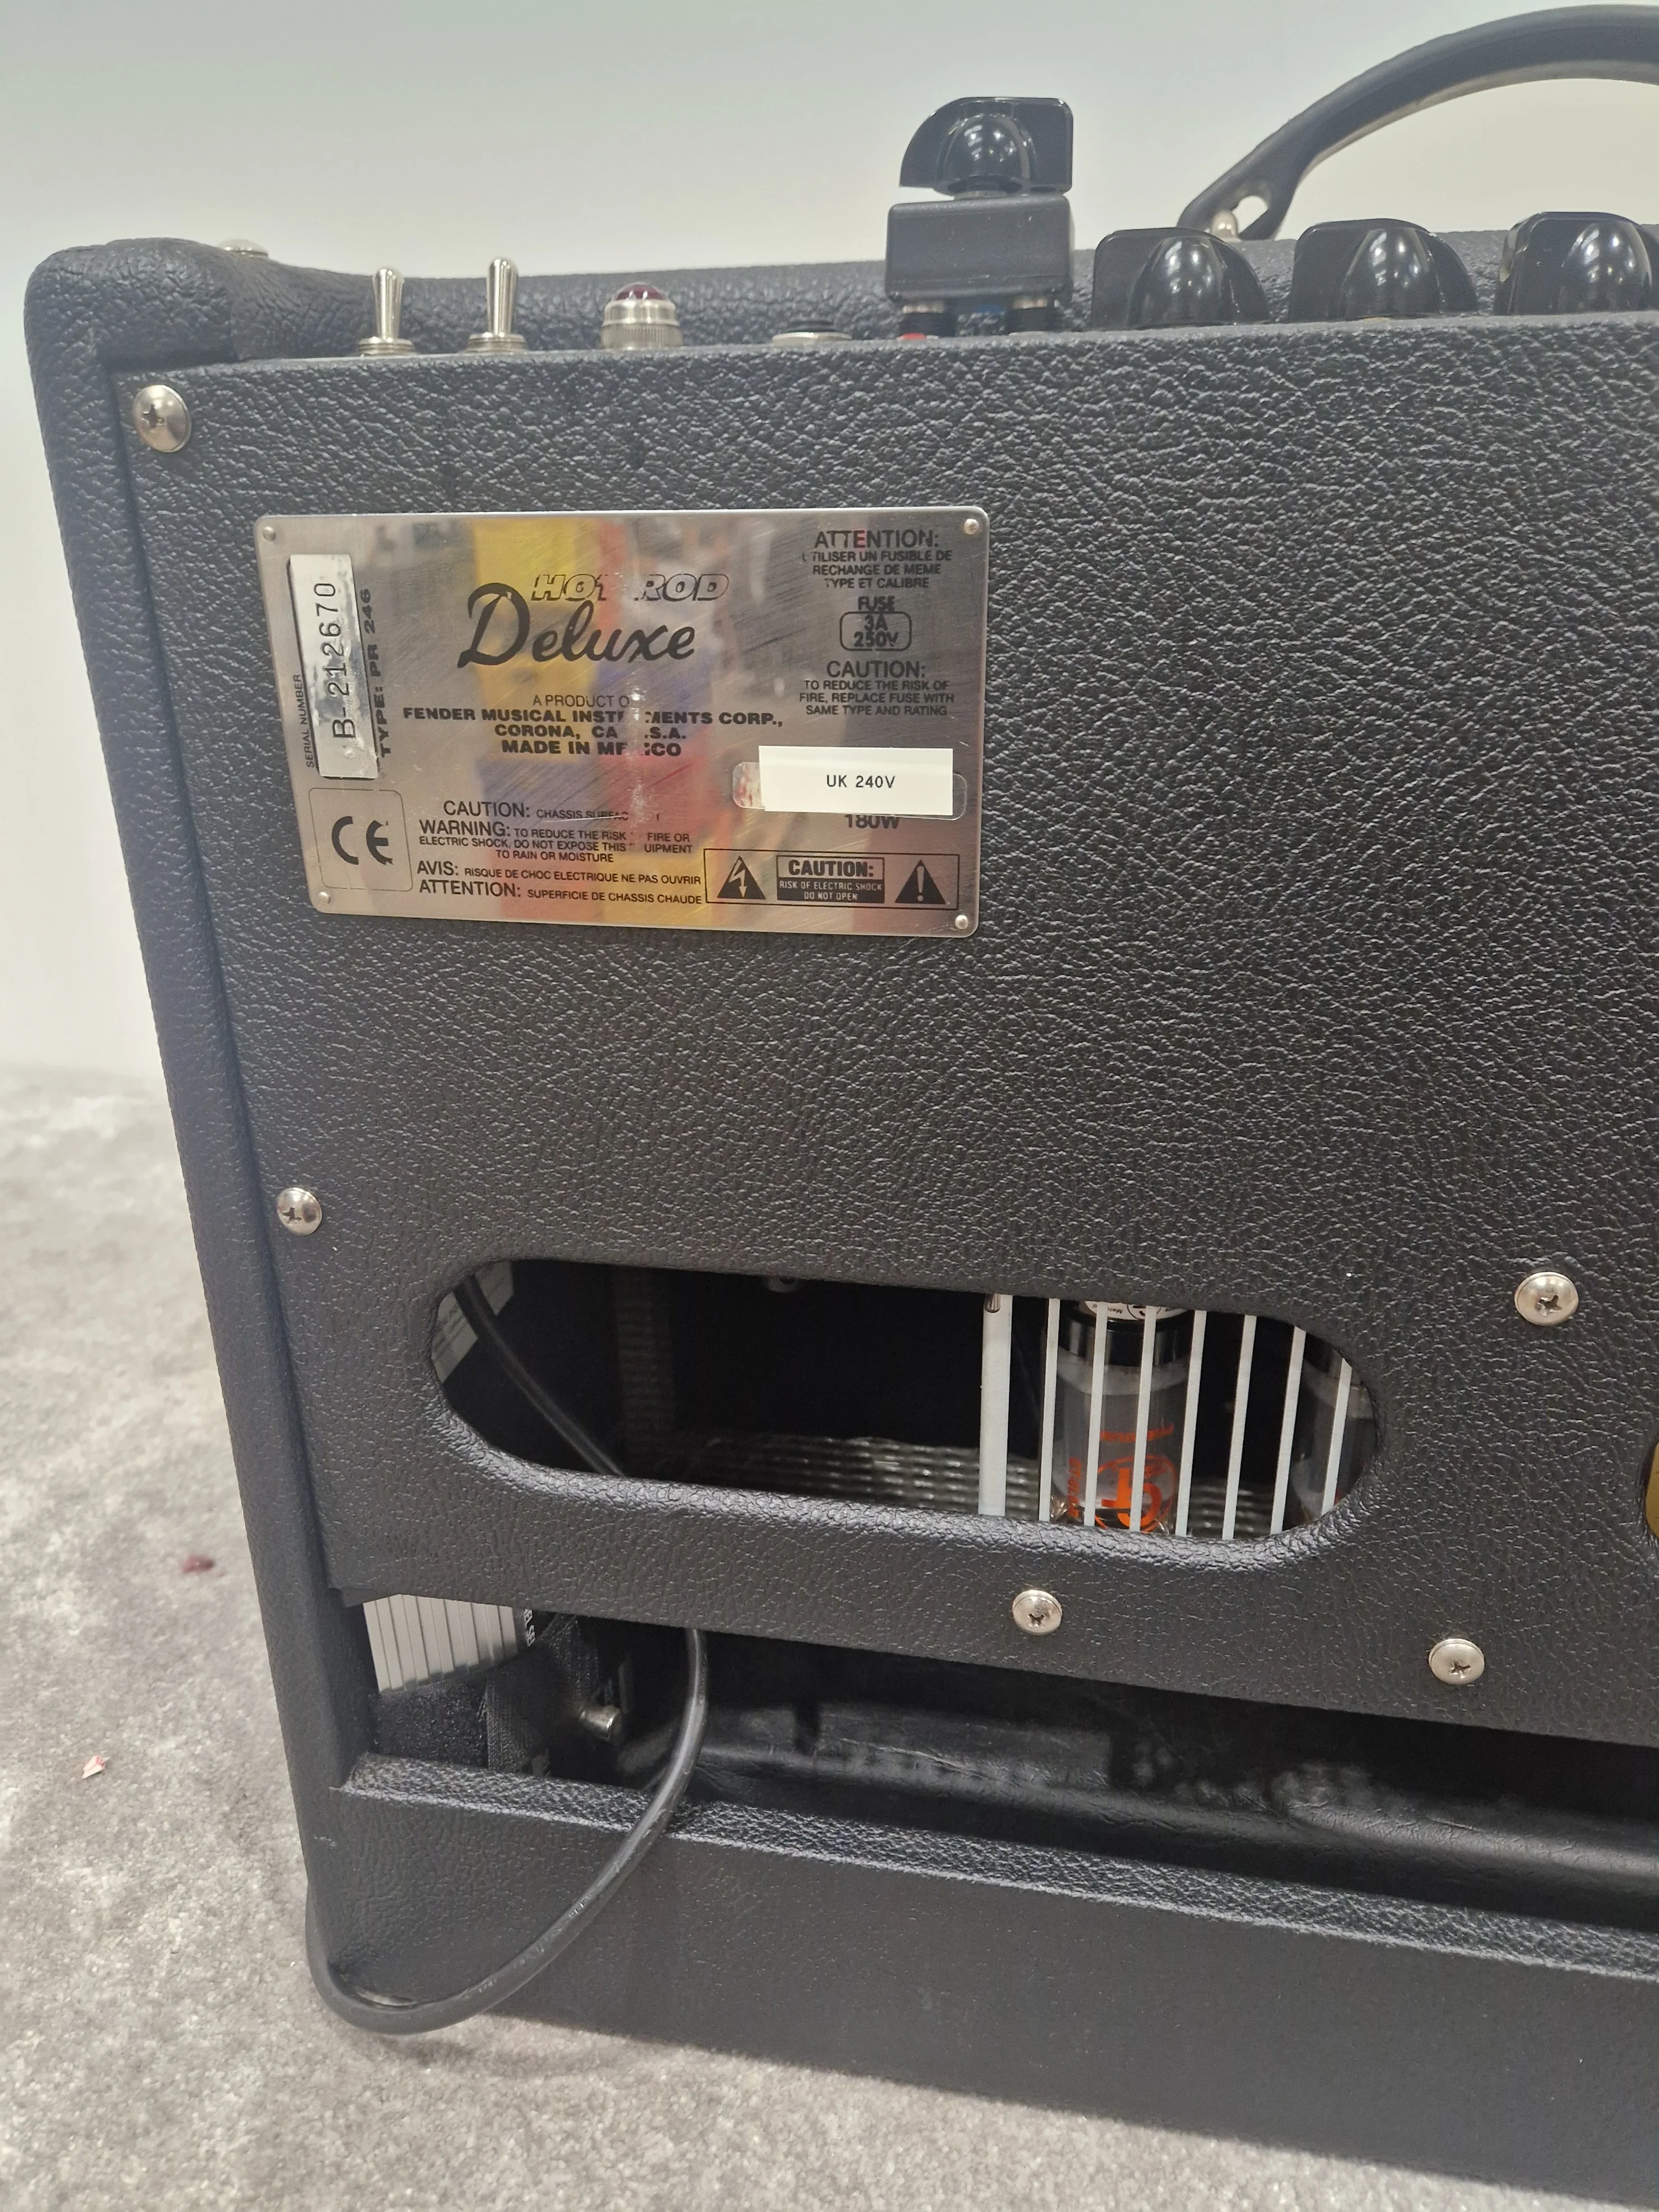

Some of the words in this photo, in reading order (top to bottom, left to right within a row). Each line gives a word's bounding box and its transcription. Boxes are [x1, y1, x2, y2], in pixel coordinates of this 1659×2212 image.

[813, 529, 939, 549] ATTENTION:
[859, 551, 877, 562] UN
[880, 550, 932, 561] FUSIBLE
[936, 550, 952, 561] DE
[813, 565, 880, 576] RECHANGE
[884, 565, 900, 575] DE
[904, 564, 941, 575] MEME
[634, 573, 729, 602] ROD
[824, 578, 855, 589] TYPE
[858, 577, 873, 588] ET
[877, 577, 930, 588] CALIBRE
[361, 588, 375, 634] 246
[858, 596, 895, 613] FUSE
[457, 582, 695, 669] Deluxe
[864, 614, 888, 631] 3A
[853, 630, 899, 648] 250V
[367, 644, 382, 677] PR
[827, 660, 926, 679] CAUTION:
[804, 680, 820, 691] TO
[823, 680, 872, 691] REDUCE
[875, 680, 899, 691] THE
[902, 680, 930, 691] RISK
[933, 680, 950, 691] OF
[294, 674, 307, 724] NUMBER
[533, 695, 542, 706] A
[545, 695, 613, 707] PRODUCT
[619, 695, 633, 708] O
[799, 692, 828, 704] FIRE,
[832, 692, 885, 703] REPLACE
[889, 692, 920, 703] FUSE
[924, 693, 954, 704] WITH
[403, 707, 476, 720] FENDER
[482, 709, 566, 723] MUSICAL
[573, 709, 713, 724] INSTMENTS
[806, 705, 838, 716] SAME
[842, 705, 872, 716] TYPE
[875, 705, 900, 716] AND
[904, 705, 948, 716] RATING
[373, 686, 391, 758] TYPE:
[494, 724, 580, 740] CORONA,
[634, 726, 686, 739] .S.A.
[302, 726, 315, 768] SERIAL
[502, 740, 562, 754] MADE
[568, 741, 591, 755] IN
[598, 742, 681, 757] MEICO
[827, 775, 847, 788] UK
[855, 775, 896, 789] 240V
[444, 800, 530, 817] CAUTION:
[536, 810, 582, 819] CHASSIS
[586, 811, 630, 821] SURFAC
[419, 819, 510, 837] WARNING:
[514, 828, 528, 837] TO
[531, 829, 575, 839] REDUCE
[578, 830, 599, 839] THE
[602, 831, 627, 841] RISK
[647, 832, 671, 842] FIRE
[674, 833, 690, 842] OR
[845, 814, 900, 830] 180W
[419, 836, 469, 847] ELECTRIC
[471, 838, 511, 849] SHOCK,
[514, 839, 529, 848] DO
[532, 840, 555, 849] NOT
[557, 841, 600, 851] EXPOSE
[602, 842, 627, 852] THIS
[629, 843, 693, 854] UIPMENT
[496, 849, 510, 859] TO
[513, 850, 537, 860] RAIN
[540, 851, 556, 860] OR
[559, 852, 614, 863] MOISTURE
[417, 860, 458, 876] AVIS:
[465, 868, 502, 878] RISQUE
[505, 869, 519, 878] DE
[521, 870, 551, 879] CHOC
[554, 871, 618, 883] ELECTRIQUE
[622, 874, 635, 883] NE
[639, 874, 658, 884] PAS
[661, 875, 701, 885] OUVRIR
[789, 859, 874, 878] CAUTION:
[419, 879, 521, 898] ATTENTION:
[528, 889, 588, 900] SUPERFICIE
[592, 892, 606, 901] DE
[608, 893, 654, 902] CHASSIS
[658, 894, 702, 905] CHAUDE
[779, 880, 797, 890] RISK
[801, 881, 811, 890] OF
[813, 881, 853, 890] ELECTRIC
[855, 883, 883, 891] SHOCK
[804, 891, 815, 900] DO
[817, 891, 833, 900] NOT
[836, 892, 858, 901] OPEN
